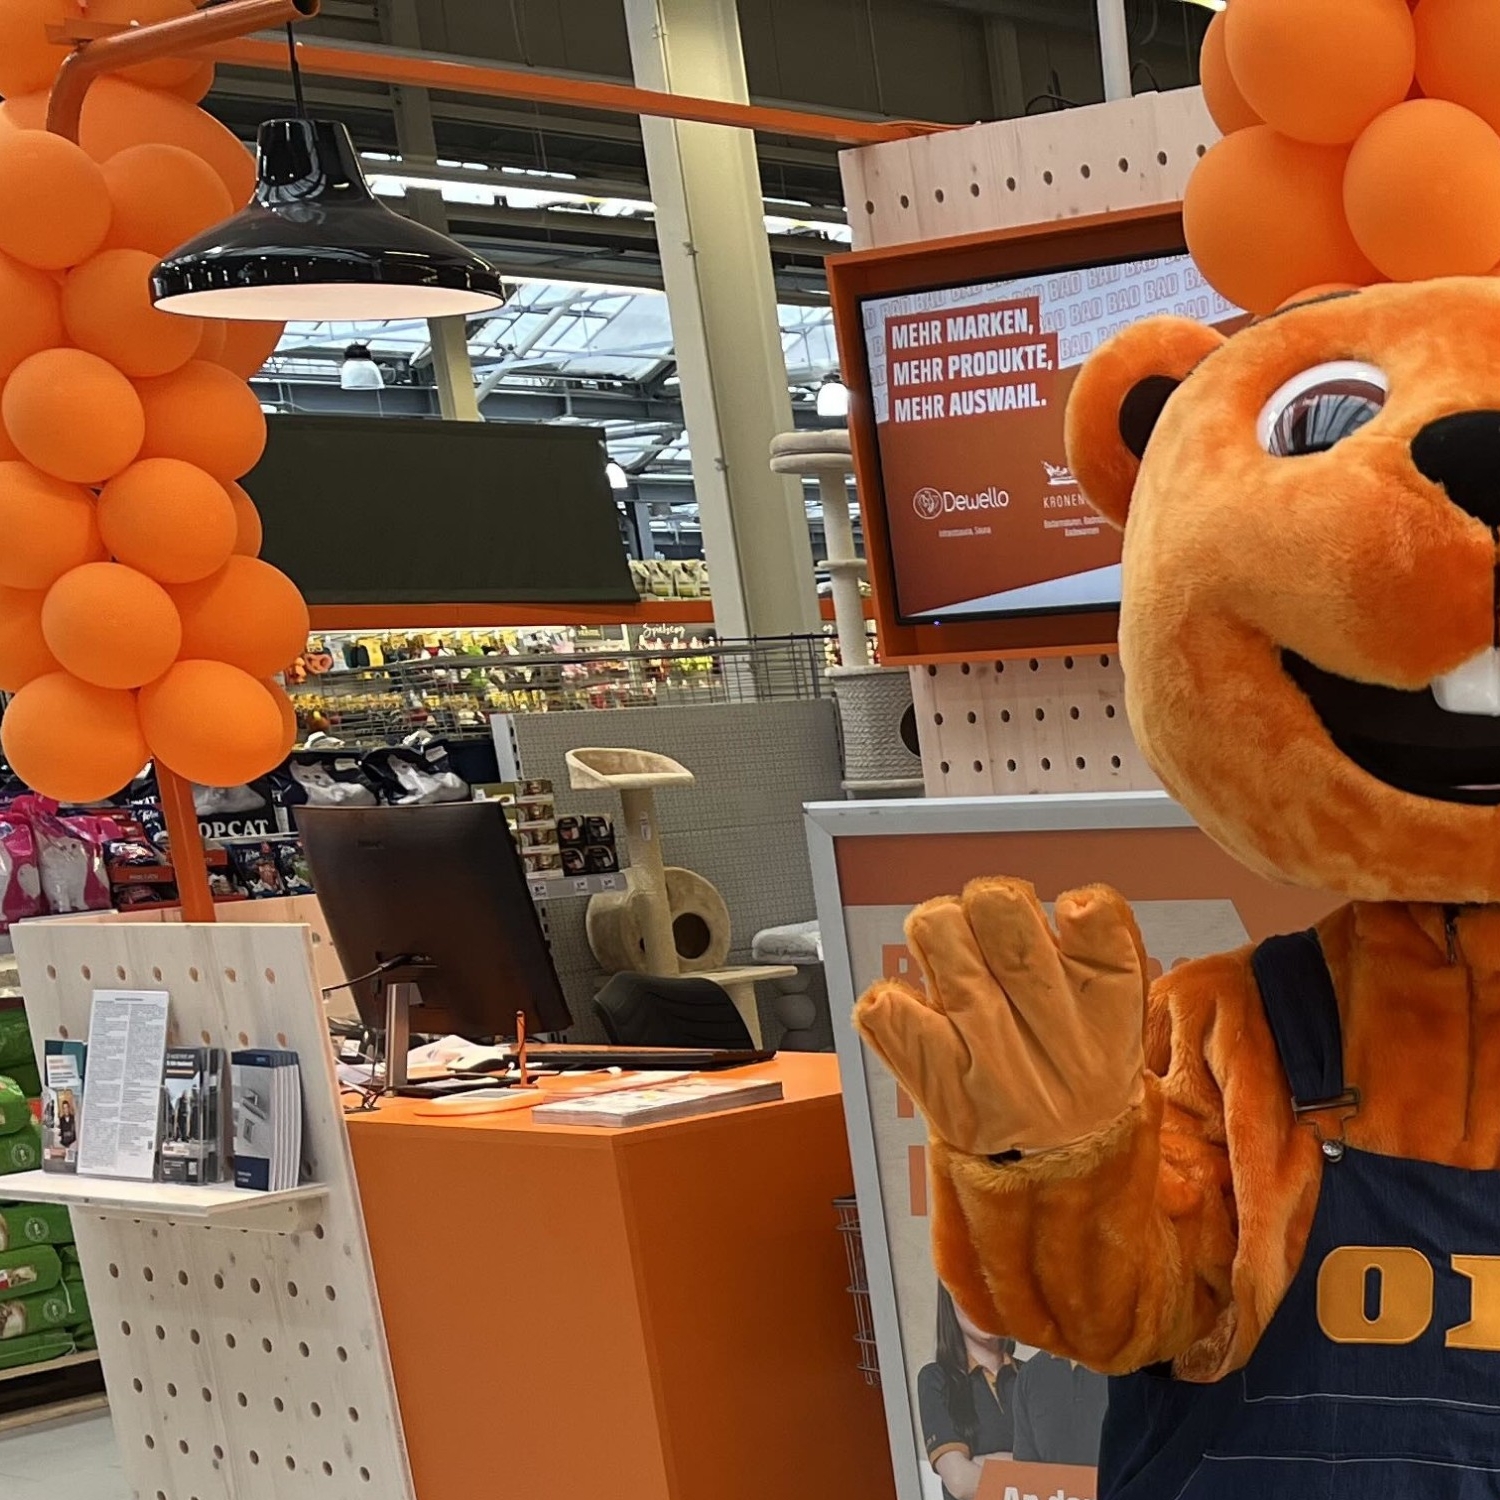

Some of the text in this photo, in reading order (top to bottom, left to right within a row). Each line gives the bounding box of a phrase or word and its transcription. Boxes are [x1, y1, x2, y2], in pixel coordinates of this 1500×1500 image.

[1041, 308, 1066, 332] AD
[1069, 297, 1104, 326] BAD
[1106, 285, 1140, 315] BAD
[1144, 273, 1178, 303] BAD
[1048, 272, 1082, 302] BAD
[891, 320, 942, 350] MEHR
[946, 308, 1034, 342] MARKEN,
[1060, 331, 1094, 361] BAD
[893, 343, 1053, 386] MEHR PRODUKTE,
[894, 383, 1047, 423] MEHR AUSWAHL.
[942, 487, 1009, 513] Dewello
